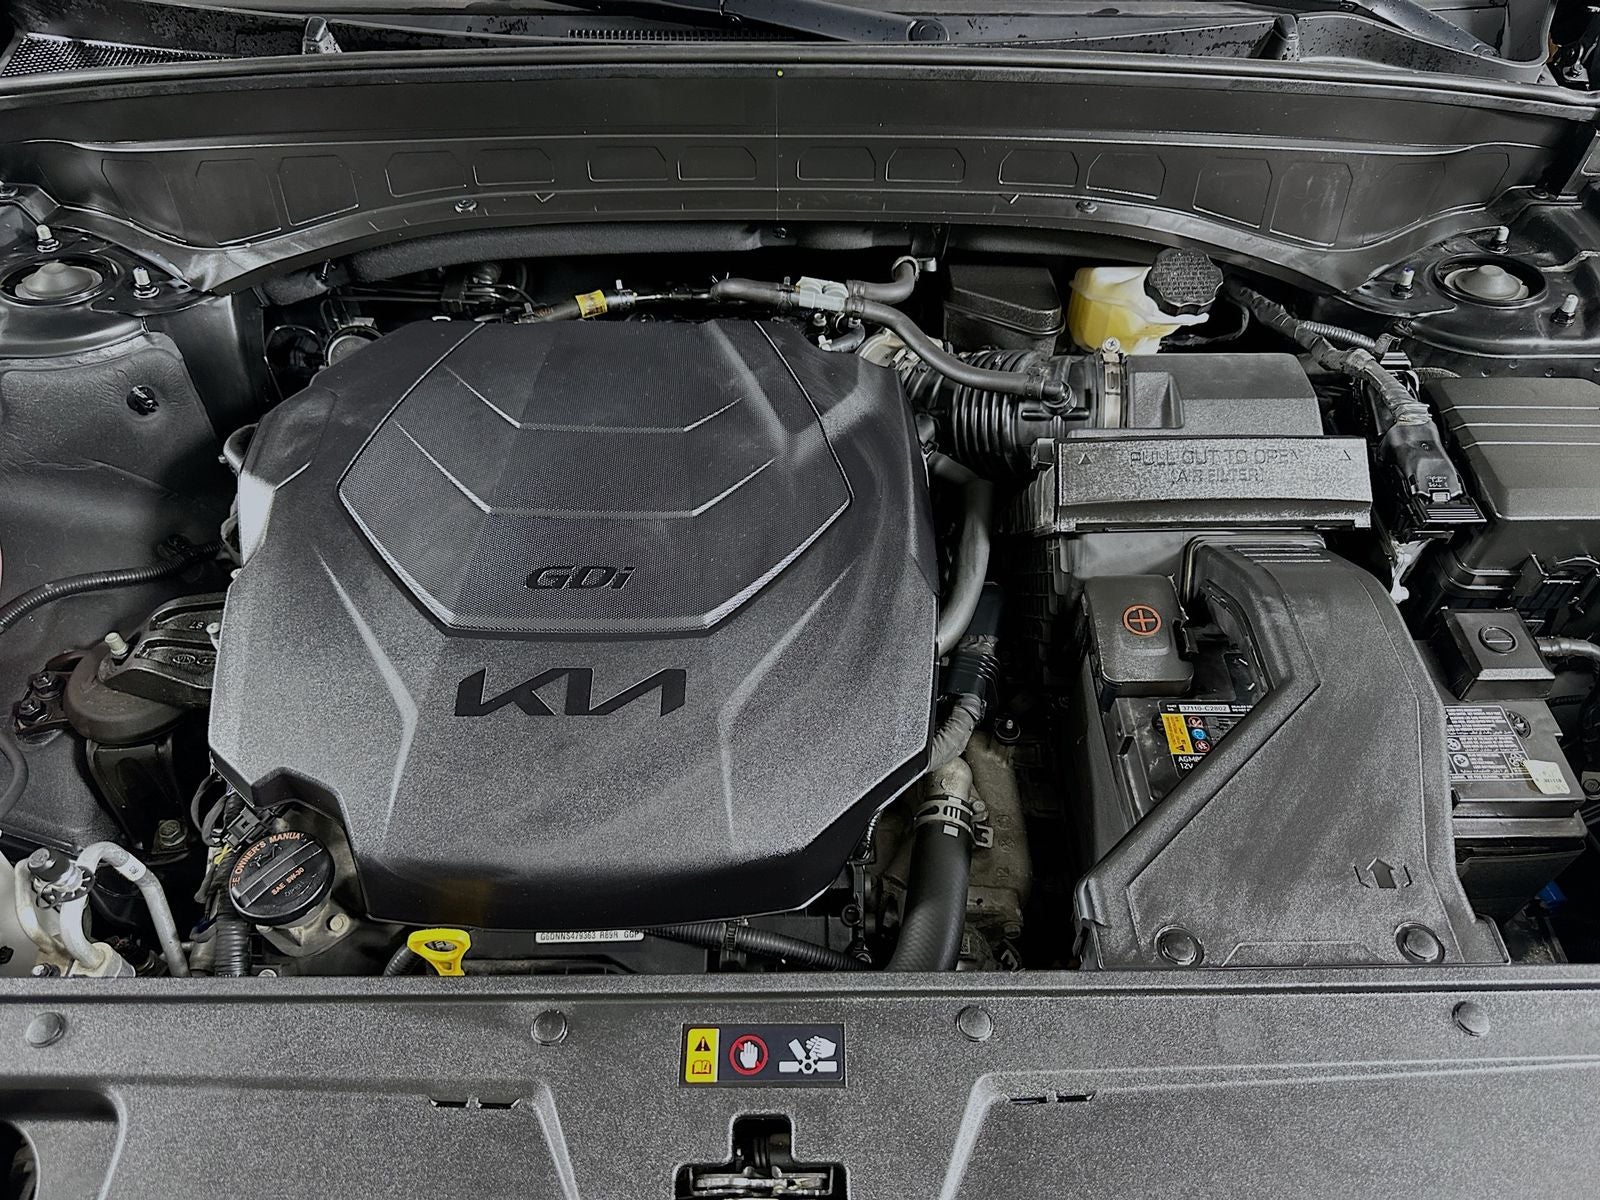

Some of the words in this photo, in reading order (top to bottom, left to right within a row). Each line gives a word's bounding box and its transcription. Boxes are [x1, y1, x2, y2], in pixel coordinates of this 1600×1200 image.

[1130, 451, 1176, 467] PULL
[1182, 450, 1219, 466] OUT
[1224, 450, 1248, 465] TO
[524, 564, 636, 590] GDi
[454, 667, 687, 717] KIA
[235, 841, 266, 874] OWNER'S
[271, 883, 287, 895] SAE
